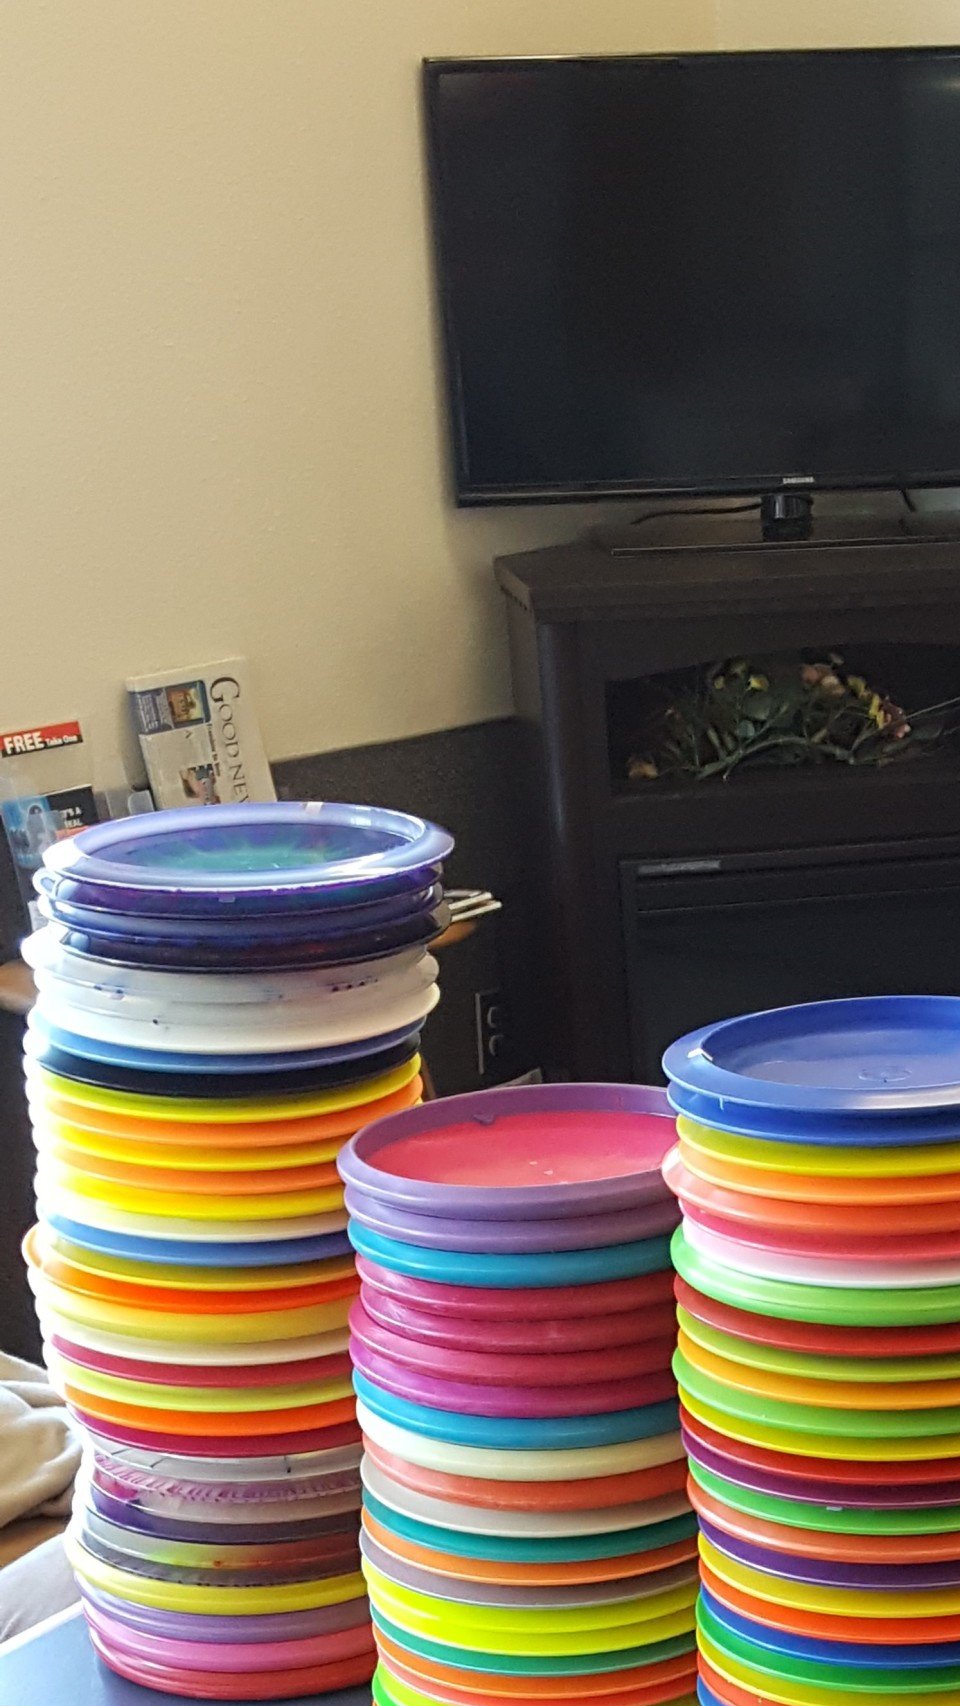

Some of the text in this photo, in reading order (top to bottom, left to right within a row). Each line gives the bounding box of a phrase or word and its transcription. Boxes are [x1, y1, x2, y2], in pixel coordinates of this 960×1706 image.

[3, 731, 78, 755] FREE Take One
[210, 676, 240, 758] GOOD
